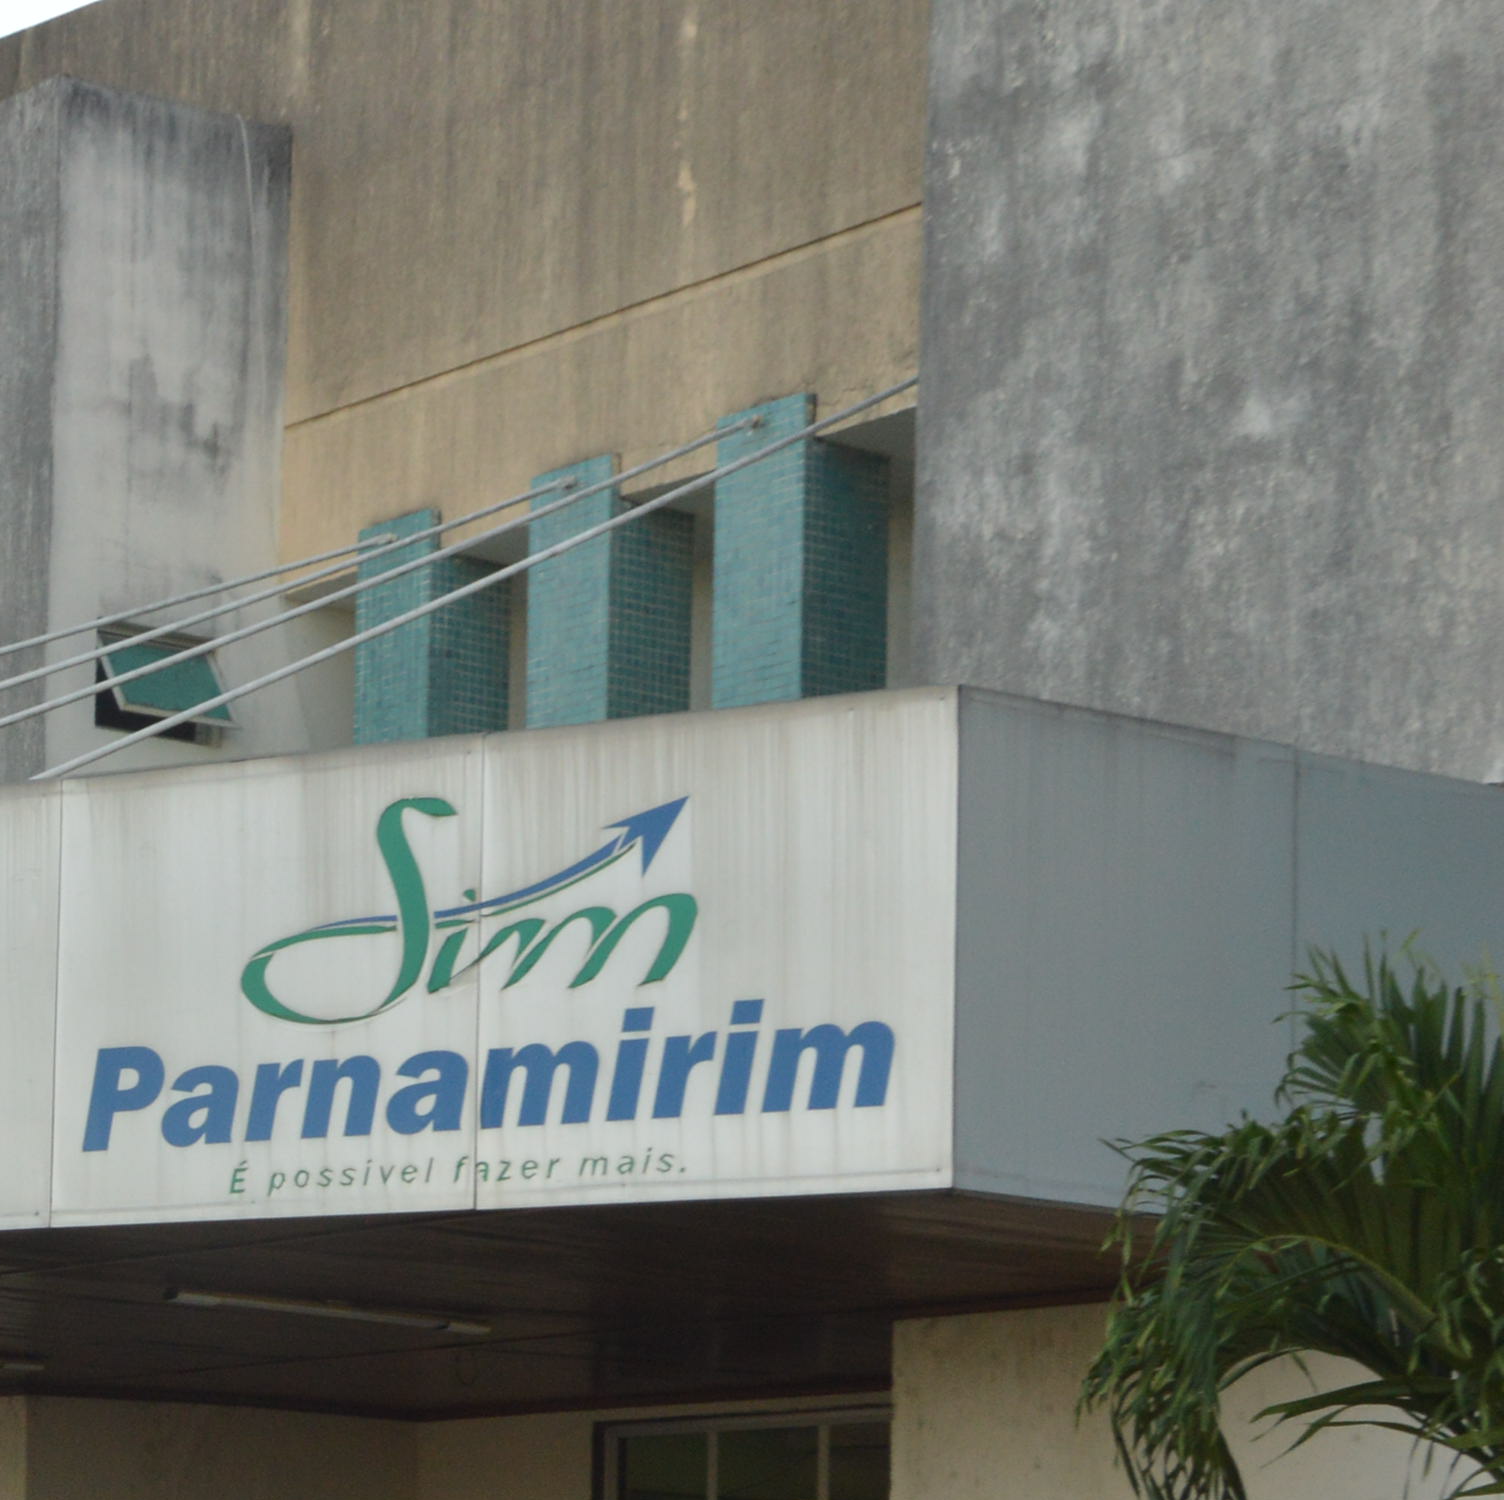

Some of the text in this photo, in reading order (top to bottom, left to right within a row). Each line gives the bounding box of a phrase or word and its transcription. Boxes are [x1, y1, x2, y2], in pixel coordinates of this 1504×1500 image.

[82, 999, 896, 1153] Parnamirim
[228, 1160, 250, 1194] É
[452, 1154, 561, 1184] fazer
